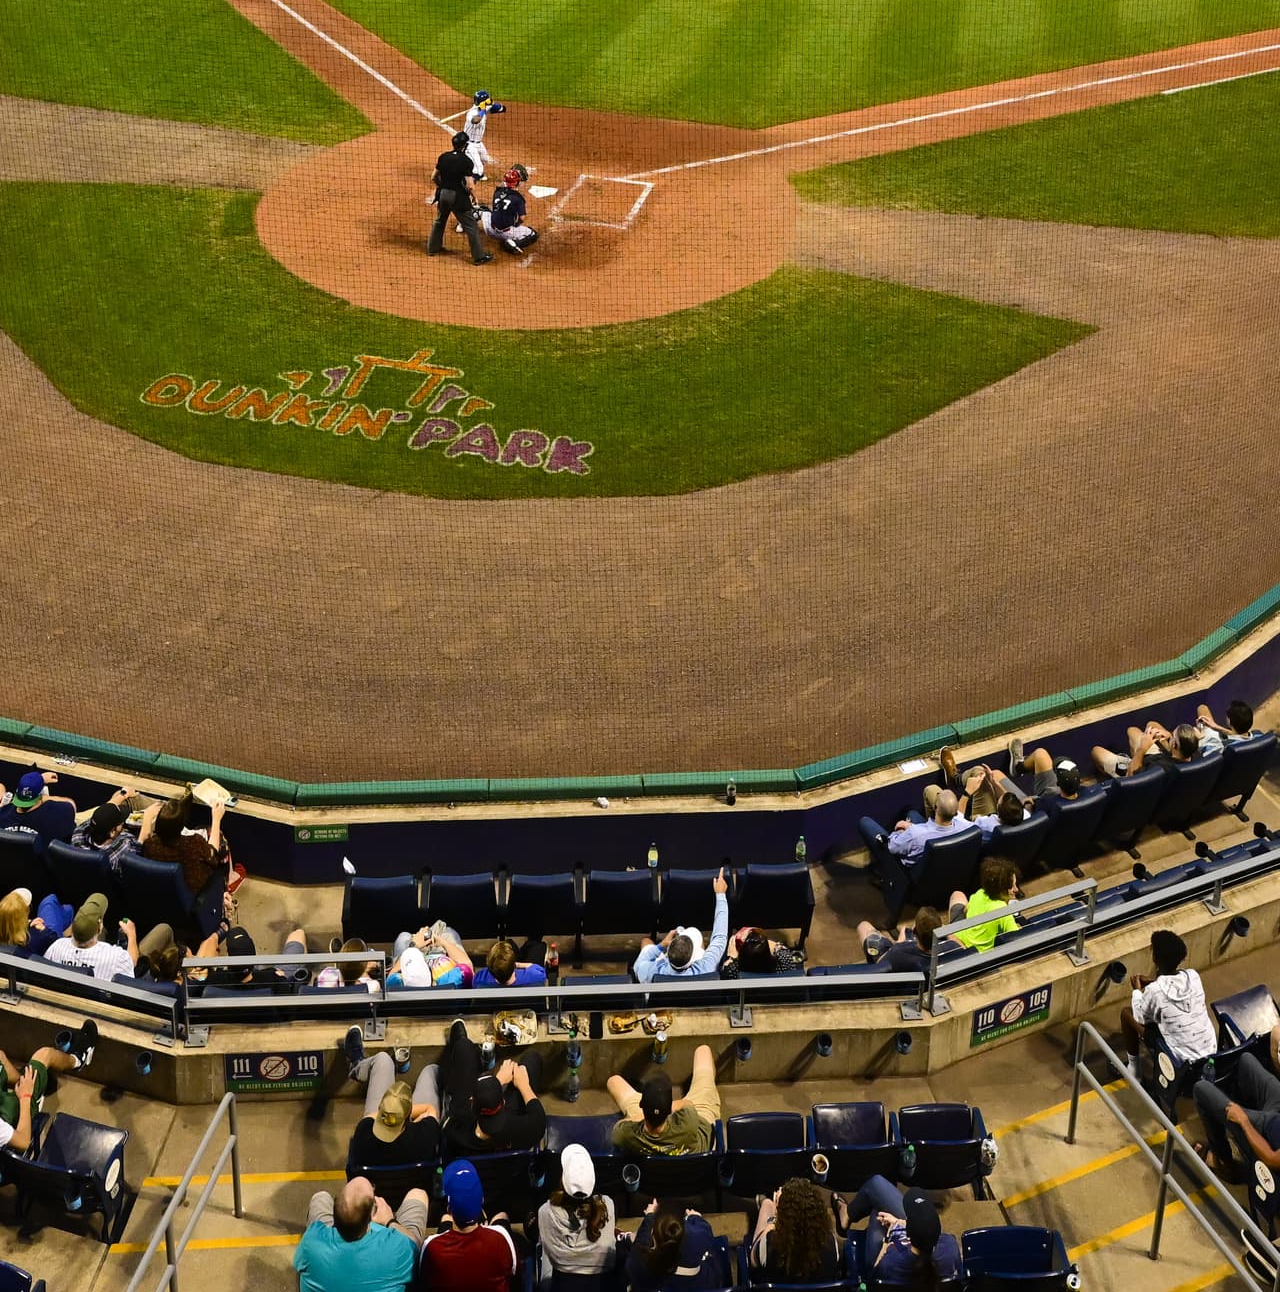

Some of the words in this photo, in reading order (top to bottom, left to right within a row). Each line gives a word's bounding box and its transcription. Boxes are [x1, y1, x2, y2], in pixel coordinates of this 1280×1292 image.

[408, 417, 595, 475] PARK
[978, 1009, 995, 1027] 110
[1030, 989, 1049, 1008] 109
[233, 1058, 250, 1073] 111
[297, 1055, 318, 1071] 110
